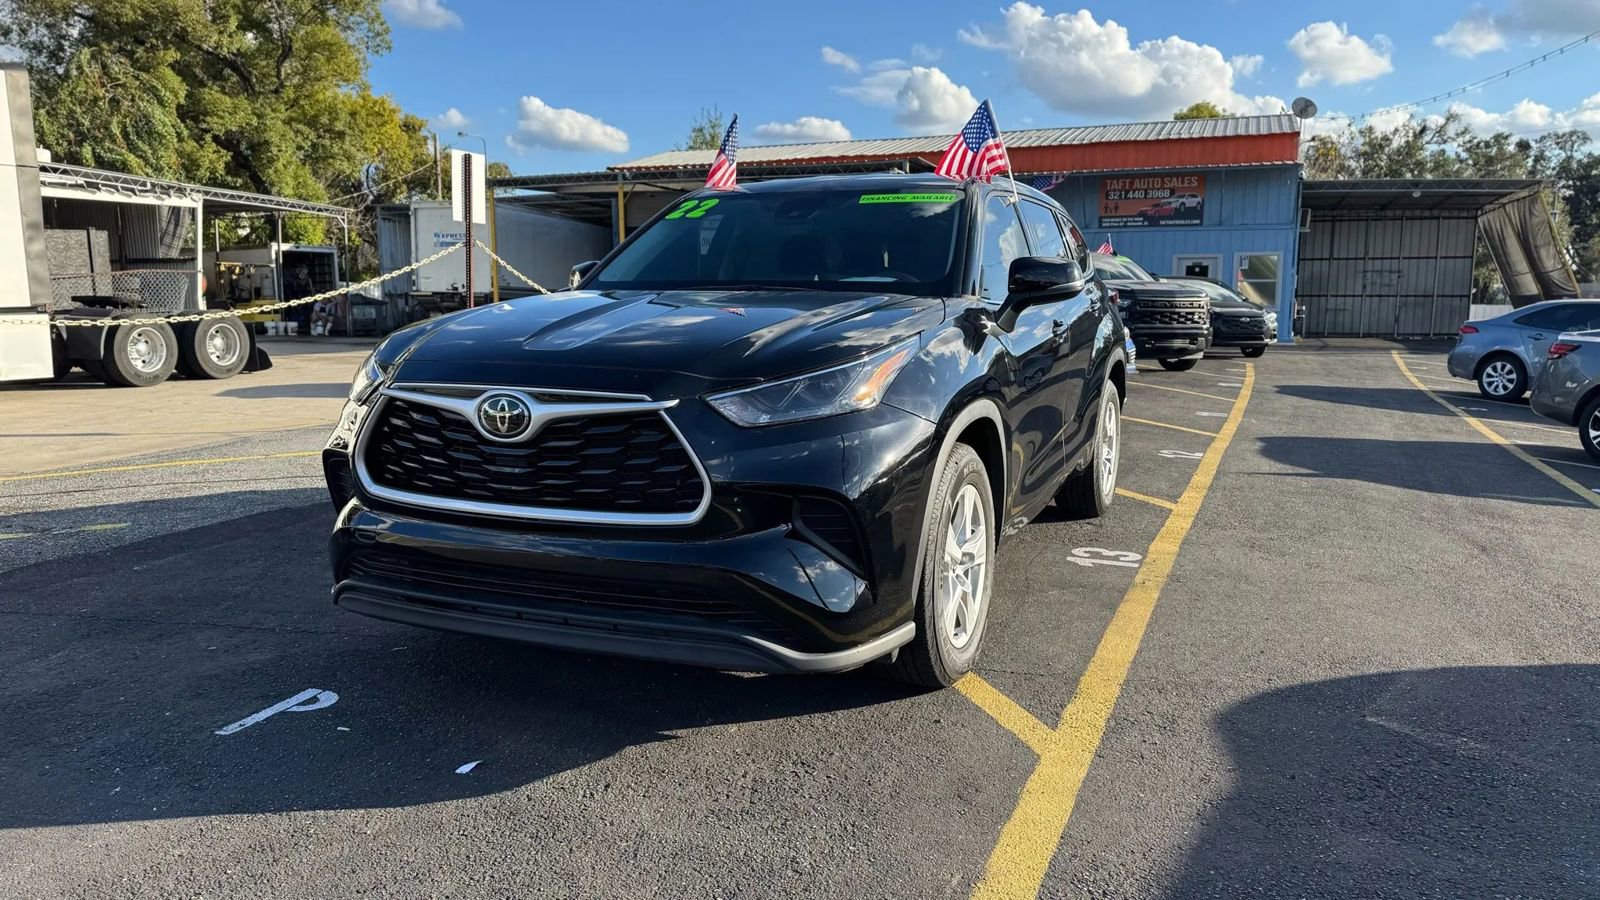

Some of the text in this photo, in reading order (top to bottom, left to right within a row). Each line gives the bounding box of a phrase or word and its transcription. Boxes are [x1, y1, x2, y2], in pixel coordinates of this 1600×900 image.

[1106, 176, 1198, 190] TAFT AUTO SALES
[1108, 189, 1170, 200] 321 440 3968
[665, 199, 720, 219] 22
[1066, 547, 1142, 568] 13
